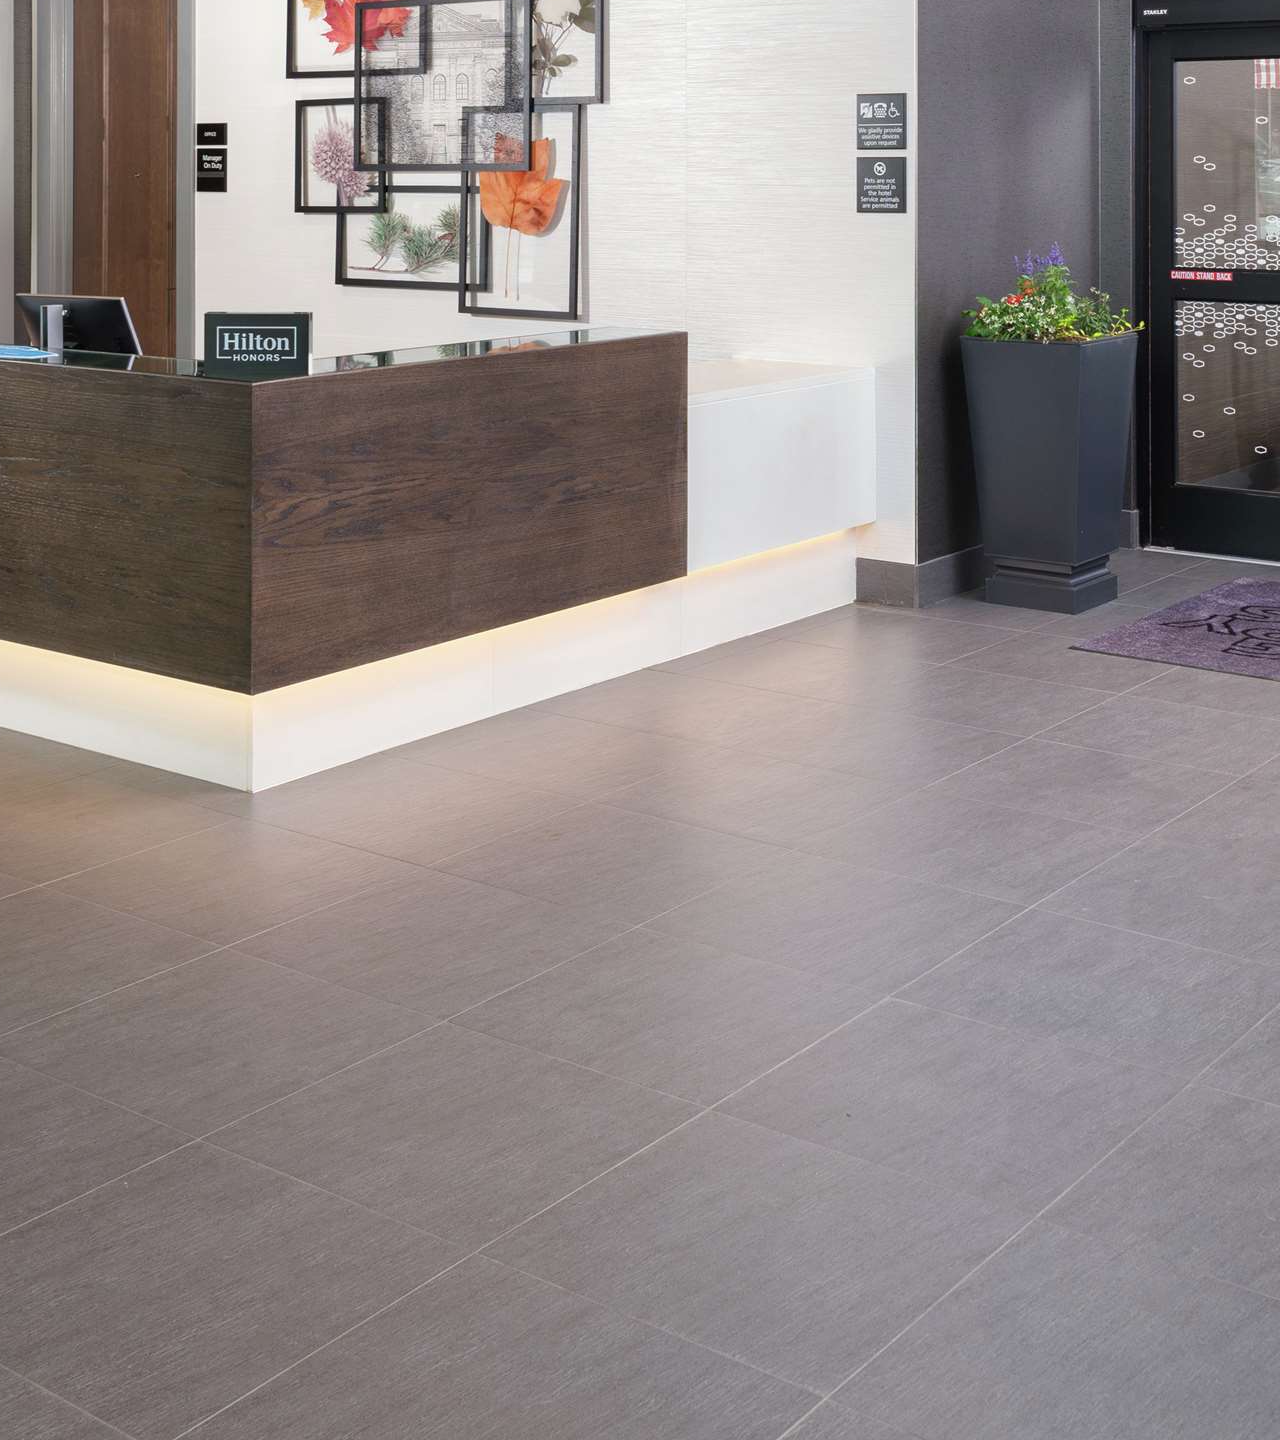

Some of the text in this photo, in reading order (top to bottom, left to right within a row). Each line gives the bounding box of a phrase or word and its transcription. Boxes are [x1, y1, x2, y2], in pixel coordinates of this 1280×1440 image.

[1171, 271, 1195, 279] CAUTION
[1216, 272, 1232, 281] BACK
[224, 333, 289, 350] Hilton
